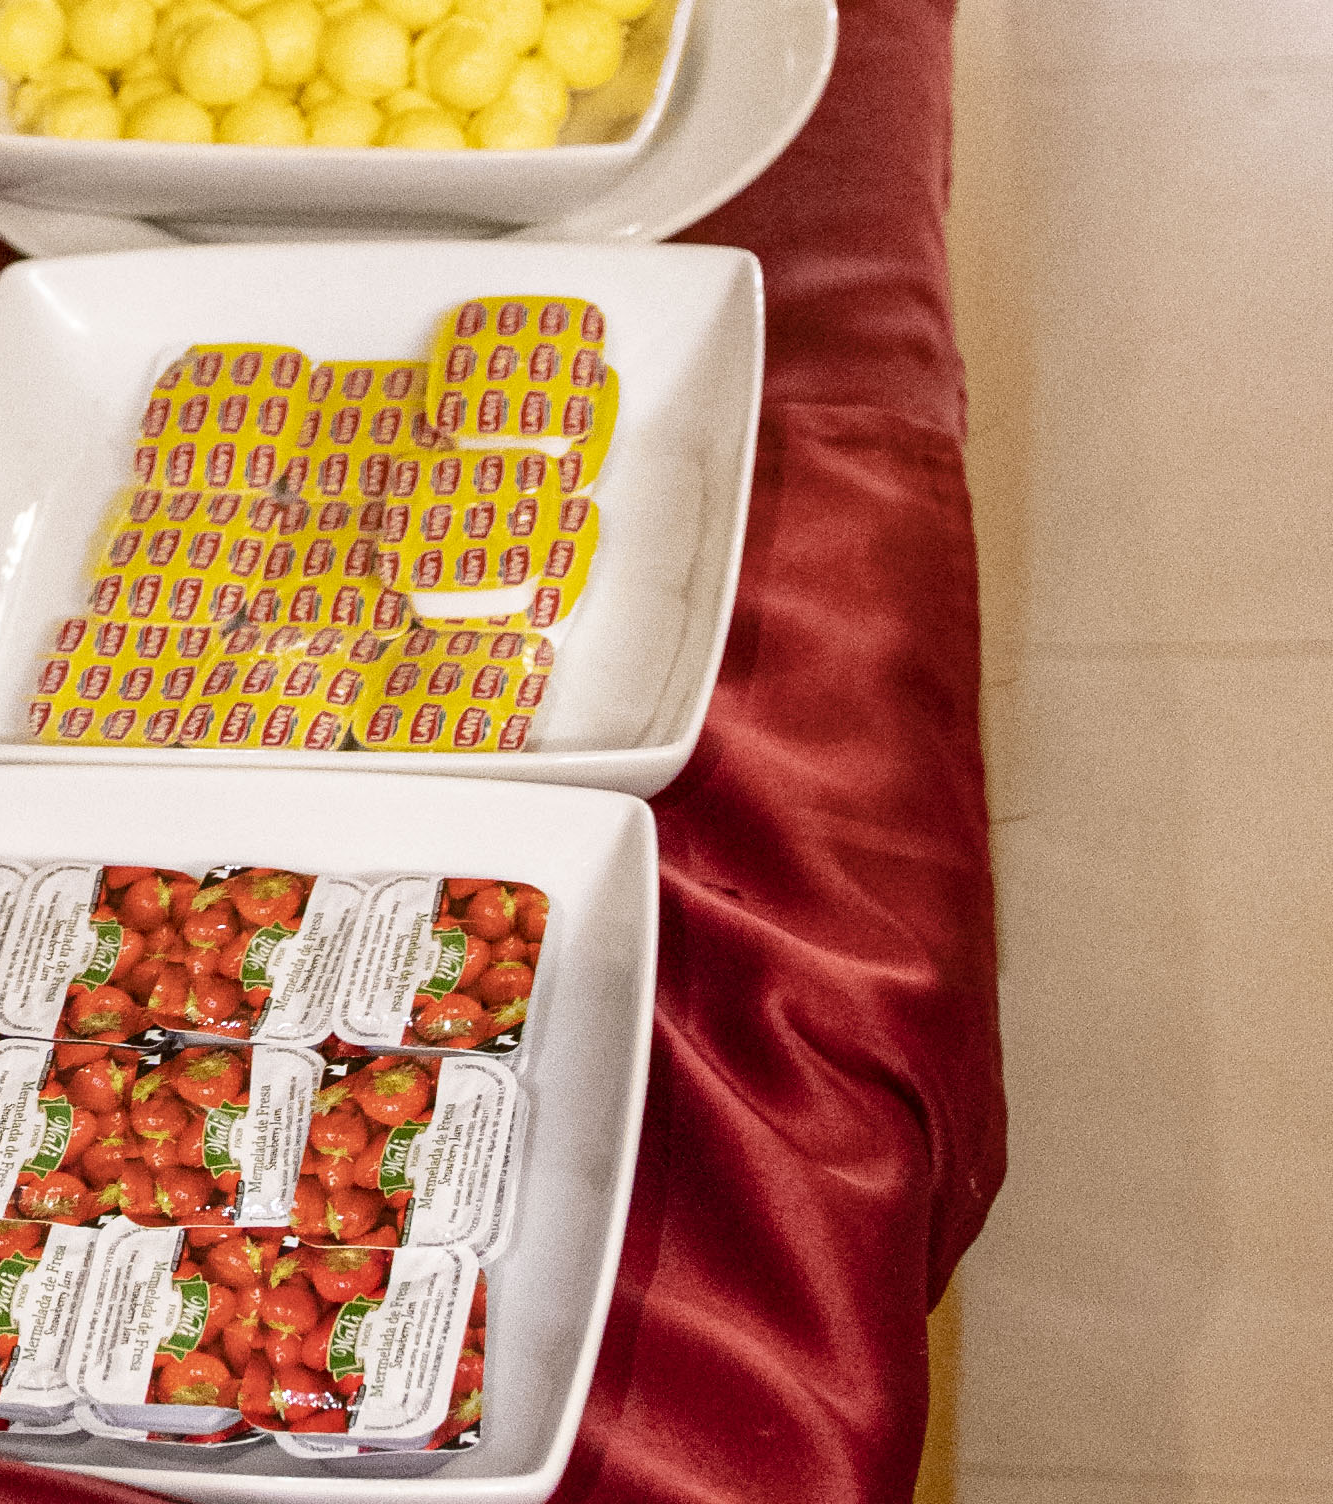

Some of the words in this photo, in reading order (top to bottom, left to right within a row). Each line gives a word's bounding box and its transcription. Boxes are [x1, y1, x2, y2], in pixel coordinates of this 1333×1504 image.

[222, 705, 249, 741] LAIVE
[263, 708, 291, 745] LAIVE
[307, 714, 332, 747] LAIVE
[412, 707, 439, 742] LAIVE
[456, 710, 483, 745] LAIVE
[59, 901, 87, 958] Mermelada
[302, 911, 324, 942] Fresa
[403, 912, 429, 968] Mermelada
[296, 943, 314, 957] de
[312, 932, 328, 952] Jam
[39, 962, 53, 982] Jam
[55, 960, 69, 975] de
[398, 969, 414, 986] de
[44, 976, 65, 1003] Fresa
[273, 958, 307, 1012] Mermelada
[383, 974, 399, 991] Jam
[390, 983, 410, 1013] Fresa
[7, 1080, 38, 1143] Mermelada
[255, 1084, 272, 1117] Fresa
[253, 1119, 271, 1134] de
[268, 1107, 283, 1126] Jam
[436, 1103, 457, 1132] Fresa
[432, 1133, 449, 1146] de
[448, 1123, 463, 1142] Jam
[3, 1144, 19, 1159] de
[242, 1134, 271, 1194] Mermelada
[417, 1147, 445, 1210] Mermelada
[45, 1244, 67, 1274] Fresa
[41, 1275, 57, 1292] de
[57, 1270, 74, 1291] Jam
[140, 1260, 169, 1319] Mermelada
[390, 1280, 411, 1308] Fresa
[386, 1310, 403, 1325] de
[401, 1301, 417, 1319] Jam
[21, 1294, 52, 1362] Mermelada
[120, 1326, 136, 1346] Jam
[136, 1321, 154, 1336] de
[129, 1338, 150, 1372] Fresa
[365, 1327, 397, 1398] Mermelada
